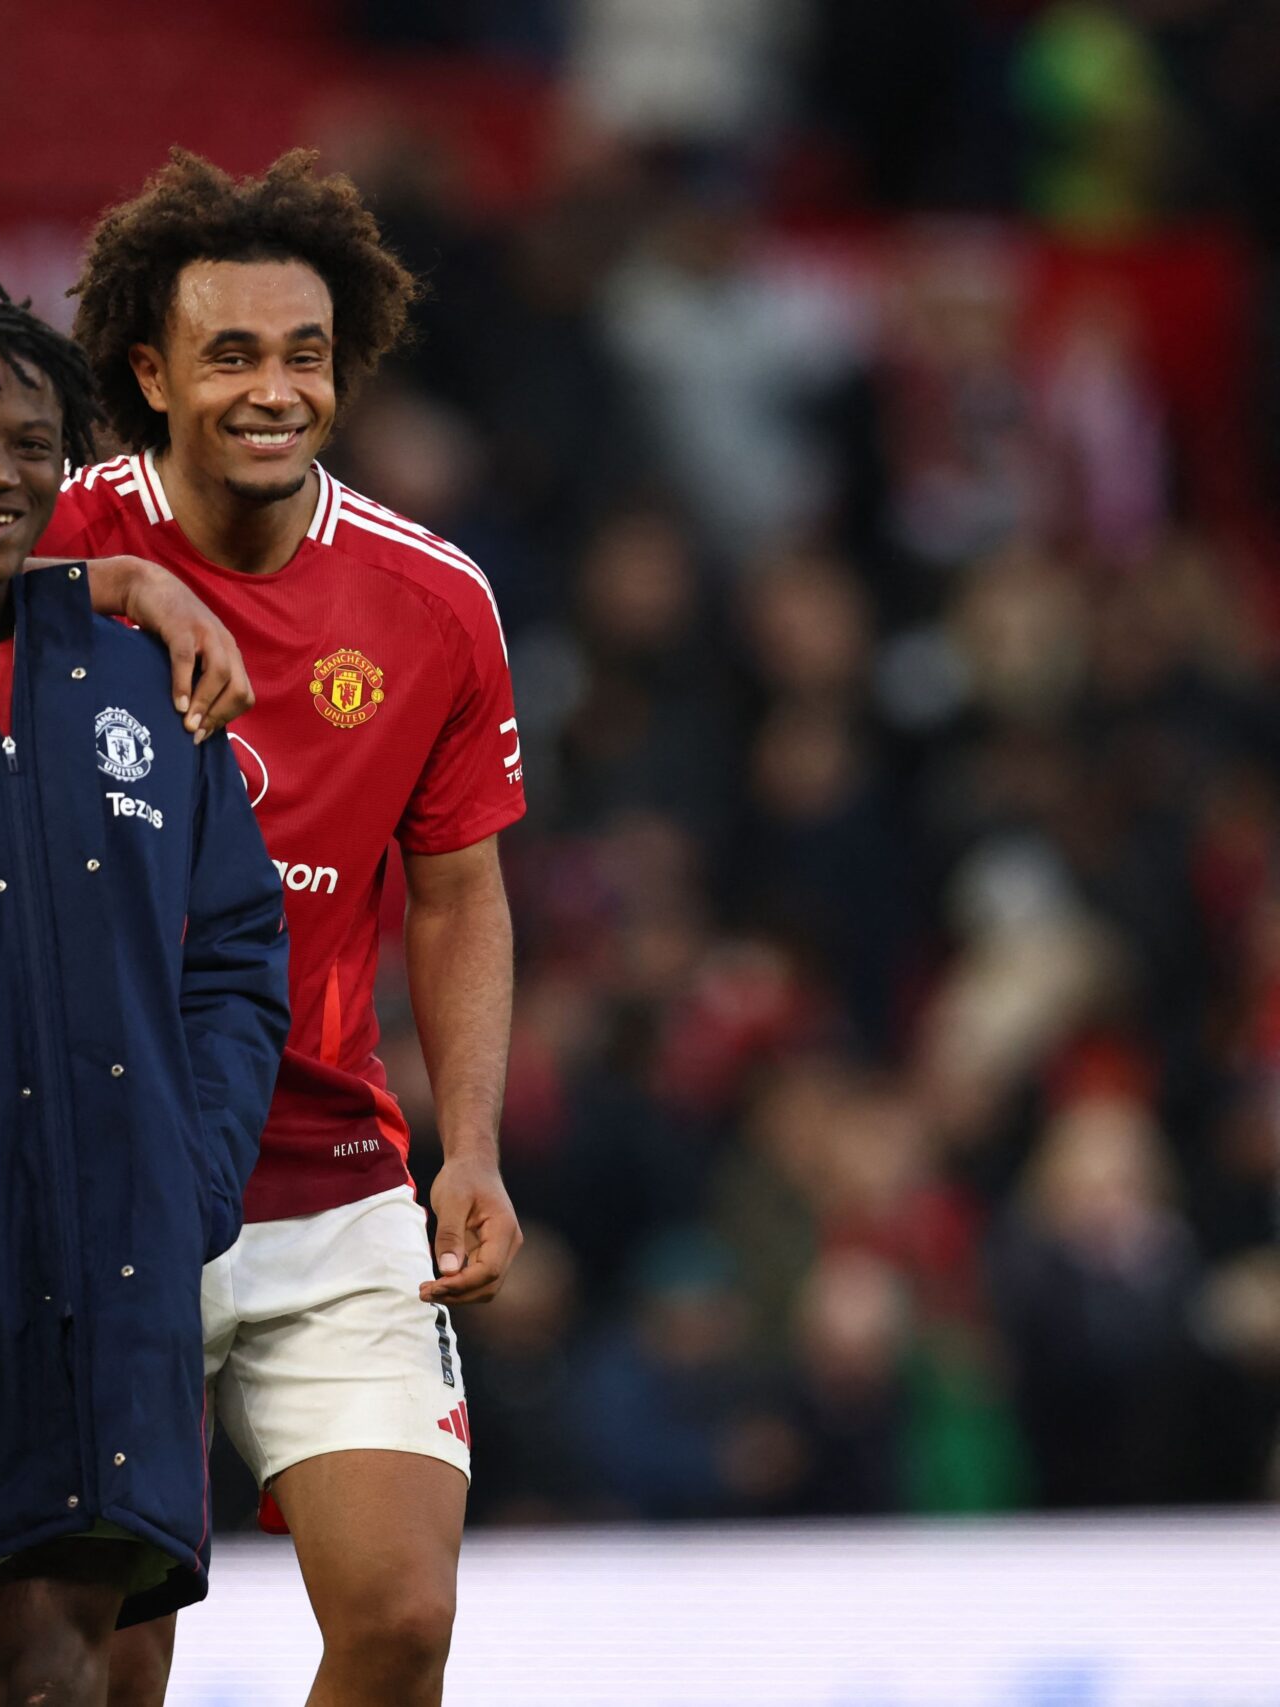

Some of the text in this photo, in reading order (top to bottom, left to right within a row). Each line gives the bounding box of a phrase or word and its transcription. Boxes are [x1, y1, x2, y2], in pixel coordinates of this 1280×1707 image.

[320, 654, 378, 684] MANCHESTER
[324, 706, 366, 723] UNITED
[104, 761, 144, 777] UNITED
[106, 792, 163, 829] Tezos
[333, 1139, 380, 1158] HEAT.RDY
